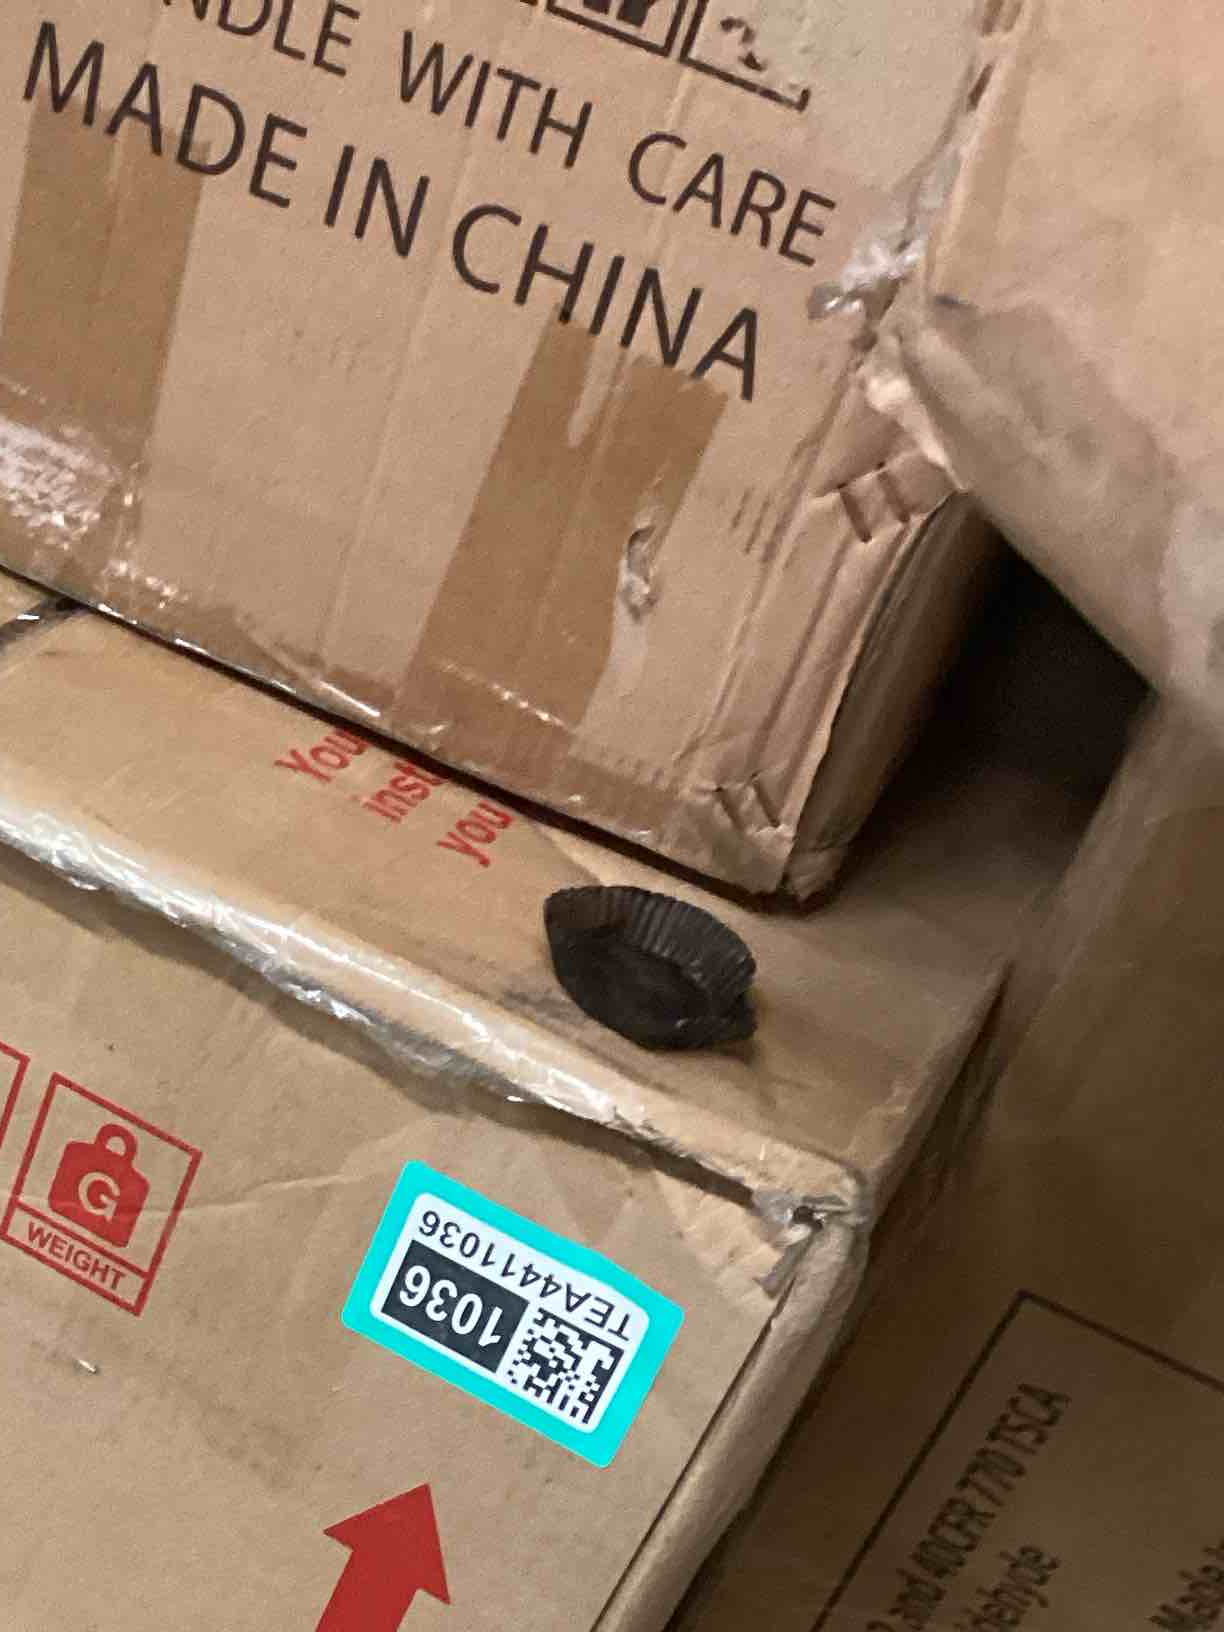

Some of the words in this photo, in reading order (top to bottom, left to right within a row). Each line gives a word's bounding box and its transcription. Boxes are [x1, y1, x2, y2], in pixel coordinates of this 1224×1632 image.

[163, 0, 360, 77] DLE
[398, 31, 593, 168] WITH
[628, 132, 835, 266] CARE
[23, 22, 308, 207] MADE
[324, 144, 430, 258] IN
[451, 204, 760, 401] CHINA
[274, 728, 369, 783] You
[437, 801, 515, 868] you
[78, 1171, 121, 1216] G
[27, 1221, 125, 1292] WEIGHT
[417, 1209, 631, 1341] TEA4411036
[398, 1264, 504, 1348] 1036
